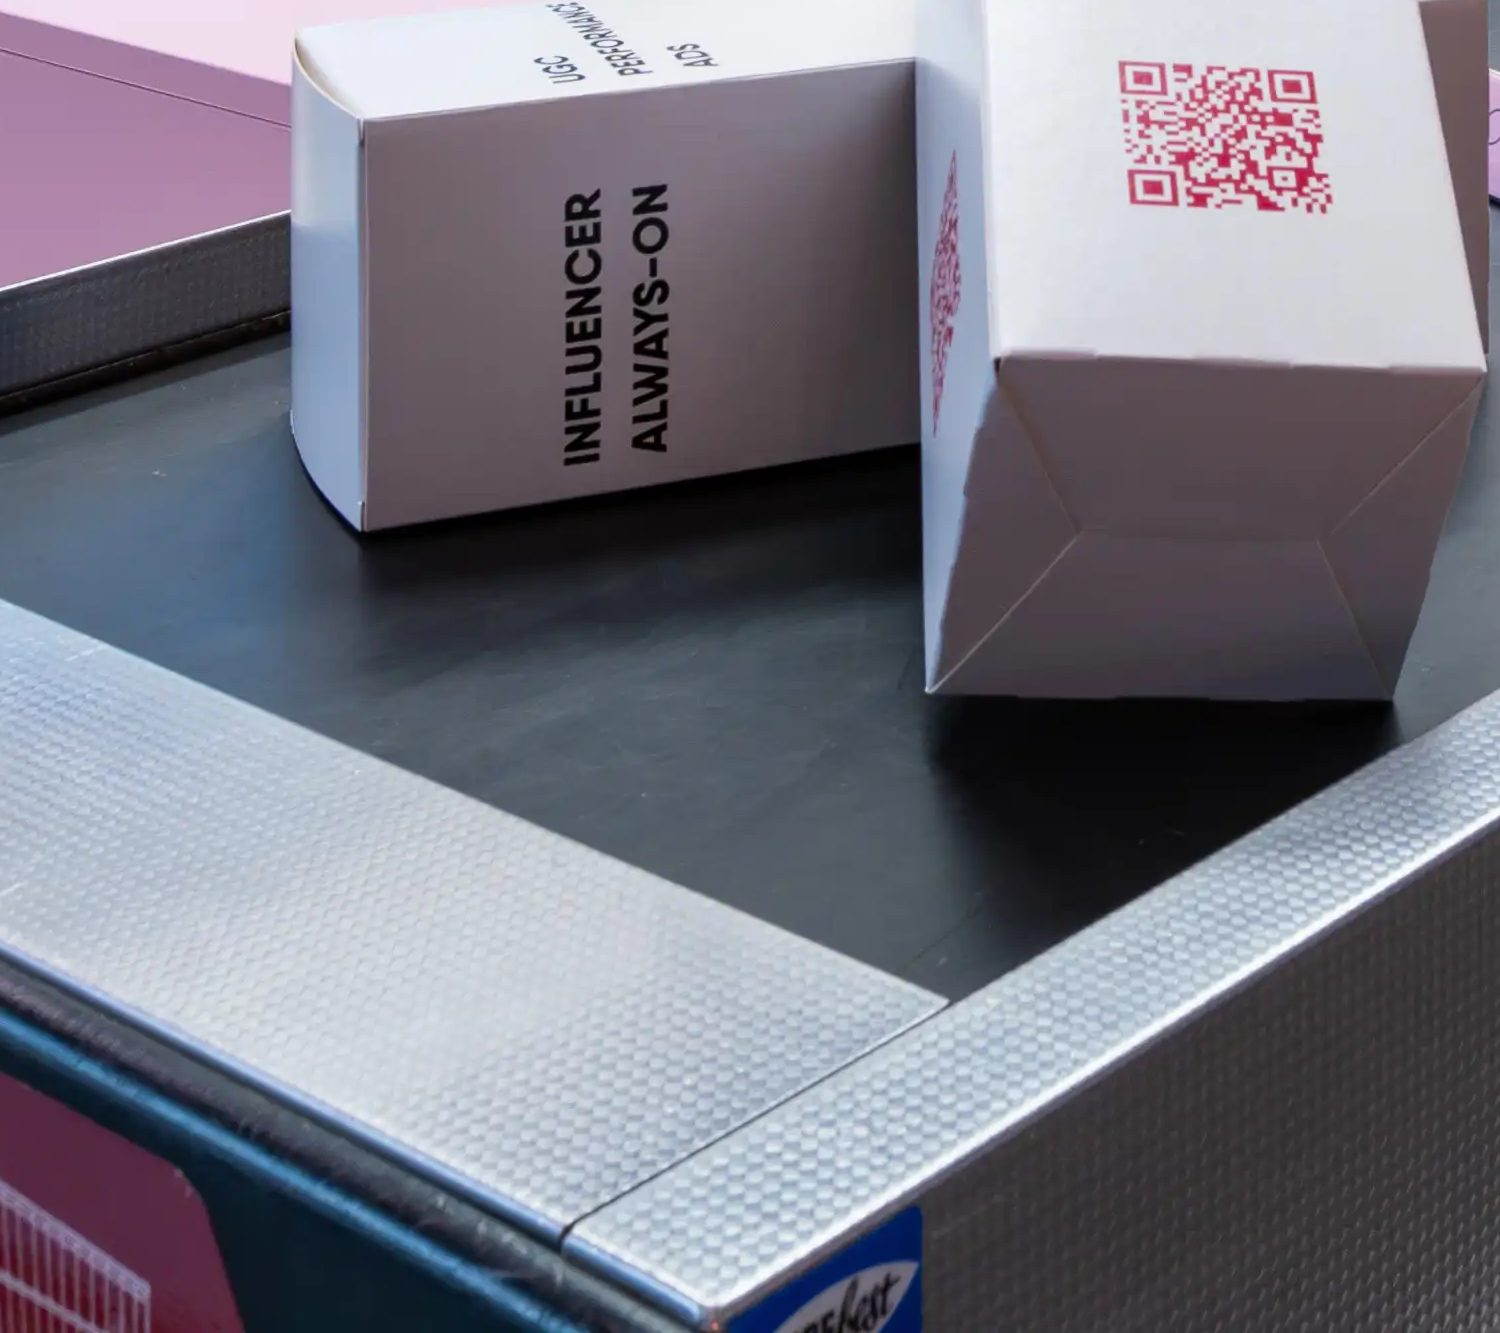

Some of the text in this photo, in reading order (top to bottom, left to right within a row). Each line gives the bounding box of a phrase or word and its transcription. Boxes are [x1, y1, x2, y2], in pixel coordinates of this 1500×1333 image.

[533, 55, 586, 84] UGC
[666, 42, 720, 68] ADS
[562, 187, 603, 469] INFLUENCER
[630, 182, 671, 455] ALWAYS-ON
